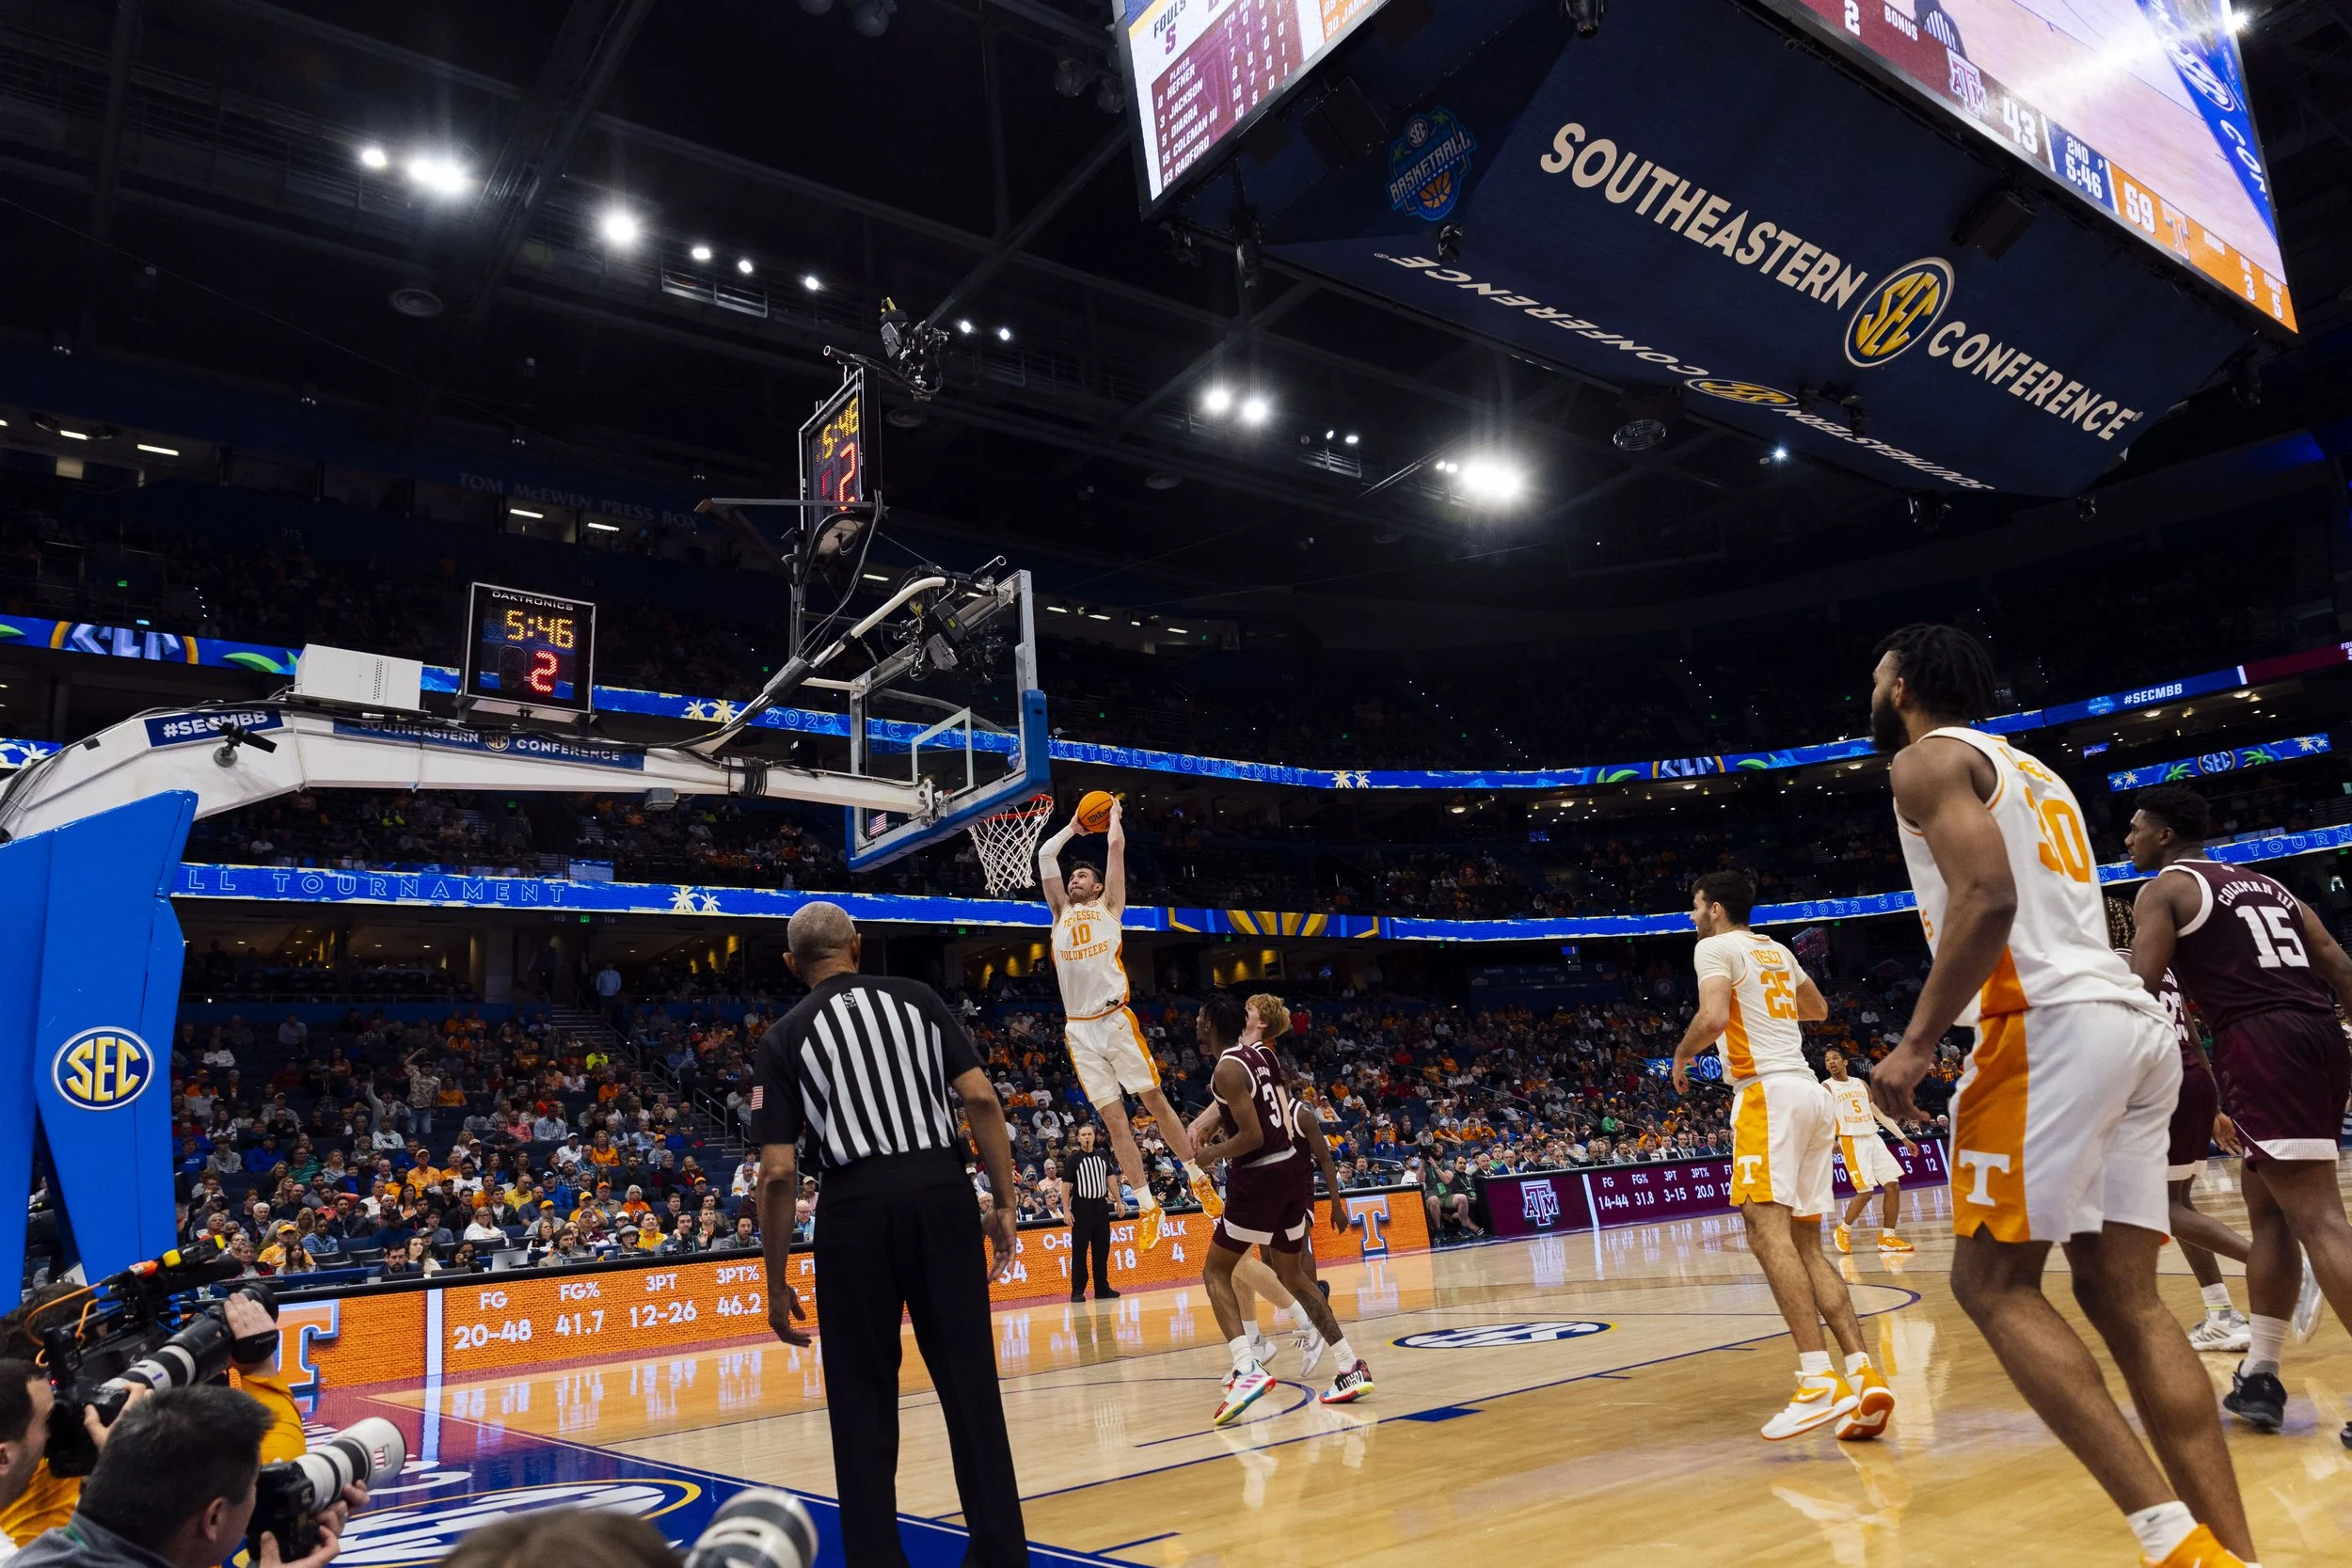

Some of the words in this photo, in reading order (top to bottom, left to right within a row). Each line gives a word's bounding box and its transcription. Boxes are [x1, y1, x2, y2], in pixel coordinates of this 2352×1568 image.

[1844, 0, 1860, 36] 2
[1884, 5, 1918, 41] BONUS
[1166, 23, 1176, 55] 5
[1168, 63, 1195, 100] HEFNER
[1243, 10, 1248, 25] 0
[1161, 133, 1167, 147] 5
[1171, 103, 1198, 139] DIARRA
[1263, 35, 1270, 51] 0
[1278, 21, 1283, 37] 0
[1168, 77, 1203, 119] JACKSON
[1230, 46, 1235, 61] 7
[1169, 56, 1190, 83] PLAYER
[1162, 150, 1170, 166] 15
[1172, 115, 1208, 157] COLEMAN
[1209, 105, 1217, 123] III
[1250, 70, 1255, 86] 7
[1266, 55, 1272, 71] 0
[2003, 97, 2039, 154] 43
[1163, 168, 1173, 188] 23
[1174, 135, 1210, 177] RADFORD
[1235, 103, 1244, 121] 10
[1268, 75, 1275, 90] 0
[2067, 135, 2090, 166] 2ND
[1390, 131, 1471, 204] BASKETBALL
[2065, 153, 2103, 199] 5:46
[2124, 181, 2155, 234] 59
[1540, 122, 1868, 310] SOUTHEASTERN
[1856, 271, 1941, 356] SEC
[1928, 321, 2136, 441] CONFERENCE
[2244, 276, 2256, 301] 3
[1388, 255, 1708, 375] CONFERENCE
[2272, 292, 2283, 319] 5
[822, 397, 858, 459] 5:46
[459, 472, 503, 494] TOM
[512, 483, 592, 510] McEWEN
[601, 499, 654, 520] PRESS
[662, 513, 697, 530] BOX
[492, 591, 574, 611] DAKTRONICS
[506, 610, 574, 649] 5:46
[531, 651, 557, 692] 2
[2123, 683, 2183, 705] #SECMBB
[516, 739, 621, 761] CONFERENCE
[766, 708, 839, 733] 2022
[1168, 753, 1305, 784] TOURNAMENT
[2201, 752, 2233, 773] SEC
[1088, 806, 1111, 823] Wilso
[273, 873, 565, 903] TOURNAMENT
[1803, 900, 1861, 917] 2022
[2217, 881, 2273, 907] COLEMAN
[2277, 893, 2295, 910] III
[1064, 910, 1102, 927] TEESSEE
[1072, 923, 1091, 946] 10
[2235, 905, 2310, 968] 15
[1060, 941, 1108, 960] VOLUNTEERS
[1760, 970, 1798, 1021] 25
[66, 1036, 142, 1102] SEC
[1701, 1056, 1722, 1080] SEC
[1262, 1083, 1282, 1128] 3
[1851, 1100, 1862, 1114] 5
[1598, 1193, 1629, 1212] 14-44
[1634, 1191, 1655, 1206] 31.8
[1663, 1187, 1687, 1203] 3-15
[1695, 1184, 1714, 1199] 20.0
[1834, 1168, 1847, 1183] 10
[1905, 1161, 1914, 1175] 5
[1925, 1157, 1938, 1172] 12
[1602, 1177, 1614, 1188] FG
[1631, 1173, 1649, 1185] FG%
[1663, 1170, 1677, 1181] 3PT
[1691, 1167, 1709, 1179] 3PT%
[1921, 1144, 1931, 1155] TO
[1737, 1155, 1762, 1184] T
[1850, 1170, 1861, 1183] T
[1958, 1148, 2010, 1207] T
[453, 1319, 532, 1350] 20-48
[555, 1309, 605, 1337] 41.7
[629, 1300, 697, 1328] 12-26
[716, 1292, 762, 1317] 46.2
[1114, 1248, 1137, 1271] 18
[1171, 1242, 1185, 1263] 4
[1346, 1196, 1390, 1254] T
[480, 1291, 509, 1310] FG
[560, 1281, 601, 1302] FG%
[645, 1273, 678, 1292] 3PT
[716, 1264, 760, 1285] 3PT%
[1109, 1226, 1136, 1243] AST
[1162, 1220, 1188, 1238] BLK
